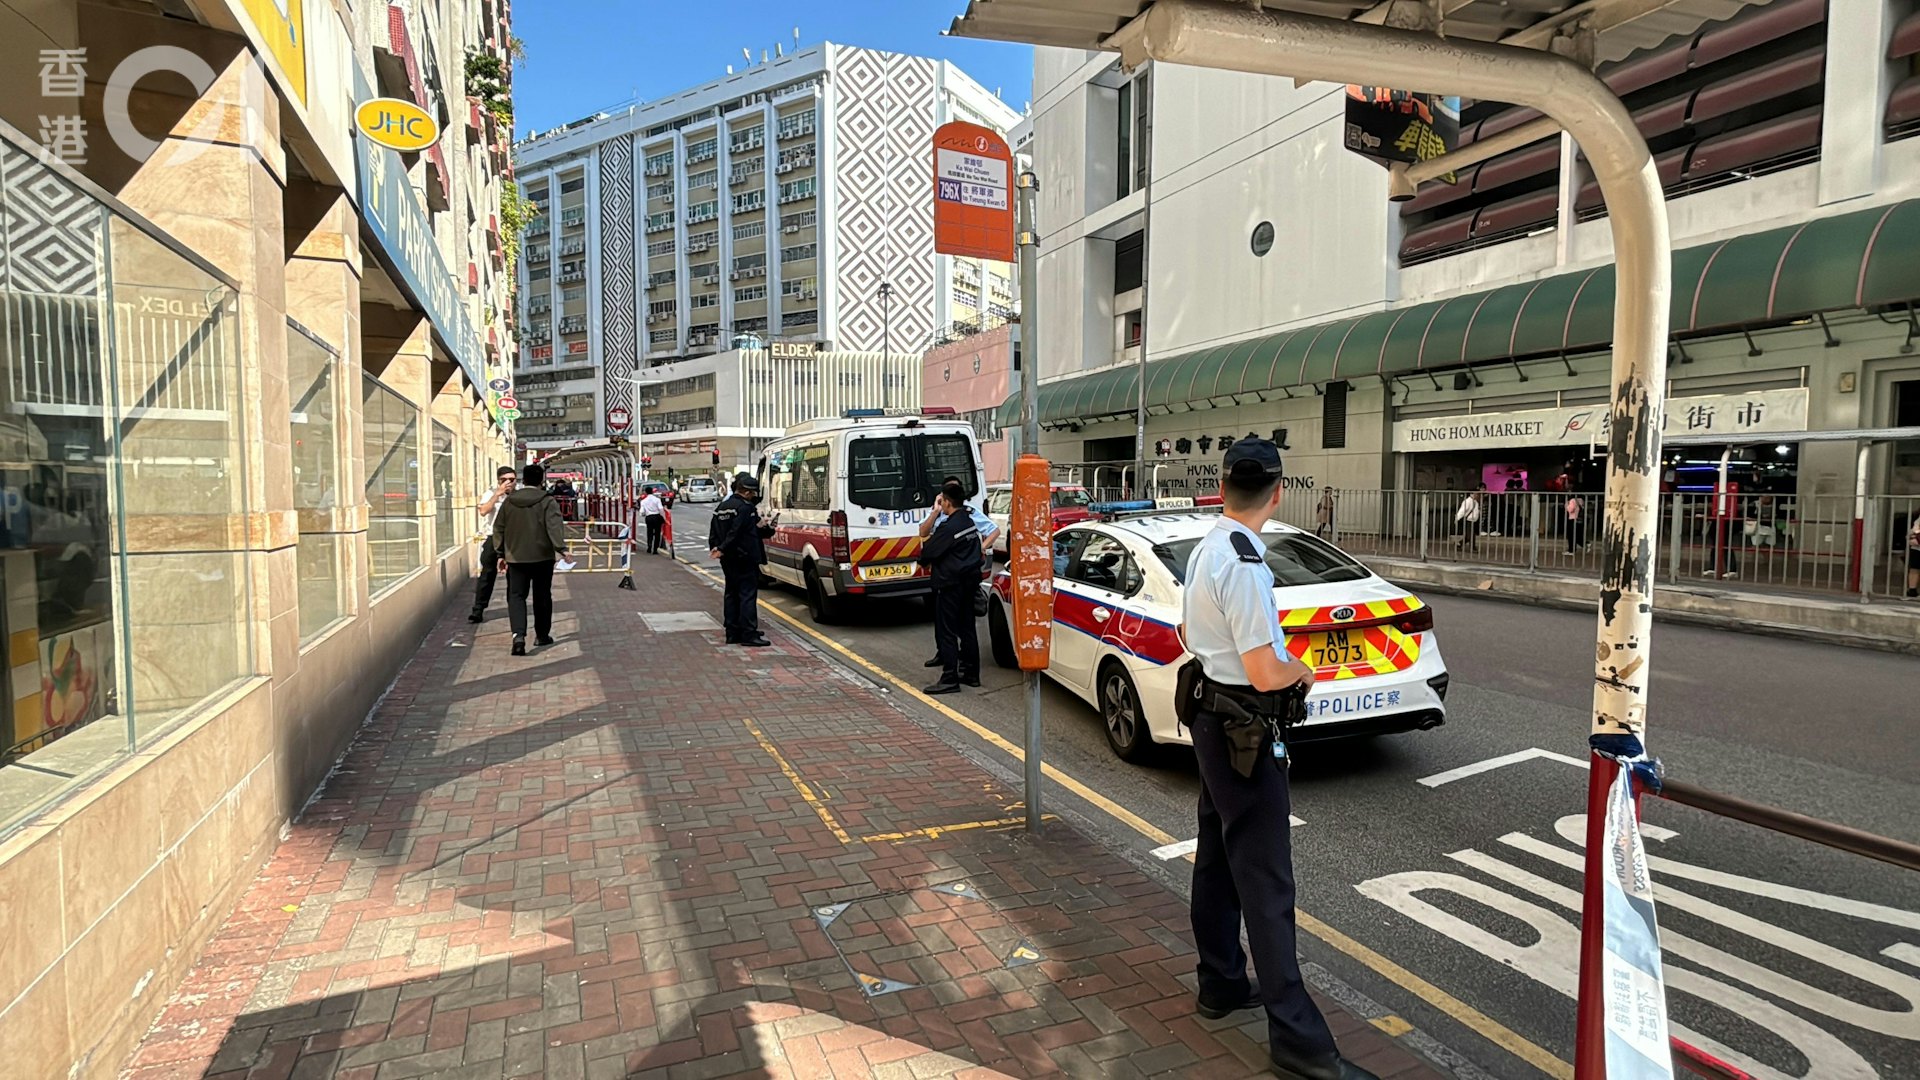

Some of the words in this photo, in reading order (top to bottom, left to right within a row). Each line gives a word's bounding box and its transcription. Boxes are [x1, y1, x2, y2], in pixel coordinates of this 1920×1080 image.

[369, 111, 423, 138] JHC
[940, 181, 960, 200] 796X
[969, 195, 987, 206] Tseung
[987, 198, 1000, 207] Kwan
[772, 343, 815, 357] ELDEX
[1410, 427, 1446, 441] HUNG
[1448, 425, 1480, 439] HOM
[1483, 421, 1544, 437] MARKET
[1187, 464, 1218, 476] HUNG
[1165, 500, 1184, 508] POLICE
[868, 568, 881, 577] AM
[883, 565, 908, 576] 7362
[1335, 607, 1353, 620] KIA
[1326, 630, 1349, 648] AM
[1314, 645, 1363, 665] 7073
[1319, 692, 1384, 716] POLICE
[1387, 690, 1401, 706] 察
